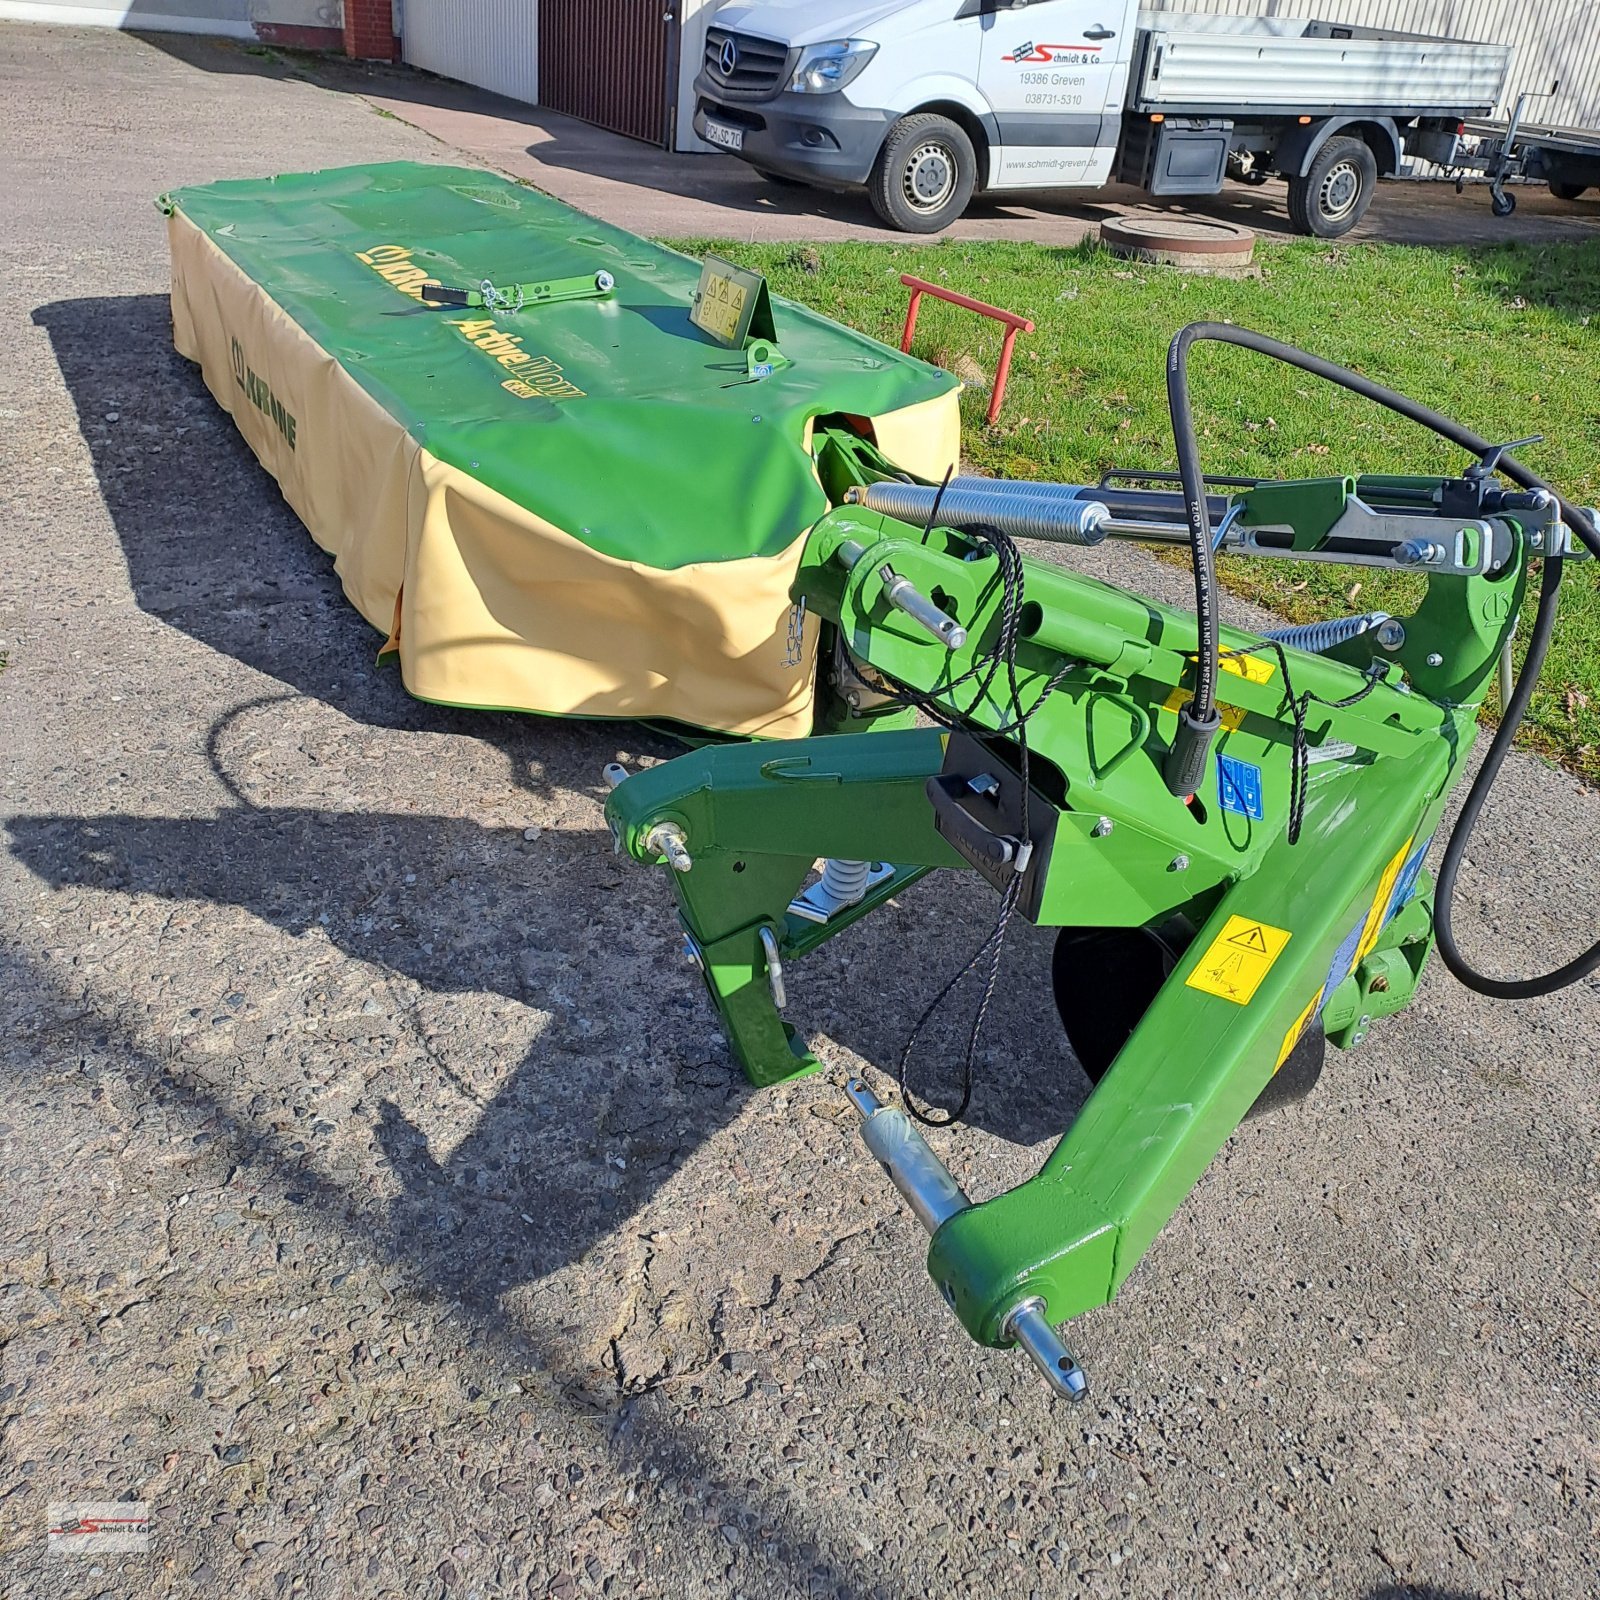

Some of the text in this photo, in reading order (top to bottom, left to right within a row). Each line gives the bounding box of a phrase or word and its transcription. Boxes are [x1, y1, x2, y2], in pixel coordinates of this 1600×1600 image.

[1081, 54, 1088, 64] &
[1090, 54, 1100, 64] Co
[1020, 73, 1086, 86] 19386 Greven
[1025, 93, 1082, 106] 038731-5310
[721, 129, 729, 144] SC
[731, 132, 741, 147] 70
[1006, 158, 1099, 169] www.schmidt-greven.de
[246, 365, 297, 453] KRONE
[1195, 532, 1205, 553] BAR
[1198, 555, 1207, 572] 330
[1200, 574, 1208, 590] WP
[1201, 592, 1210, 617] MAX.
[1202, 620, 1211, 645] DN10
[1202, 666, 1211, 684] 2SN
[1199, 684, 1210, 710] EN853
